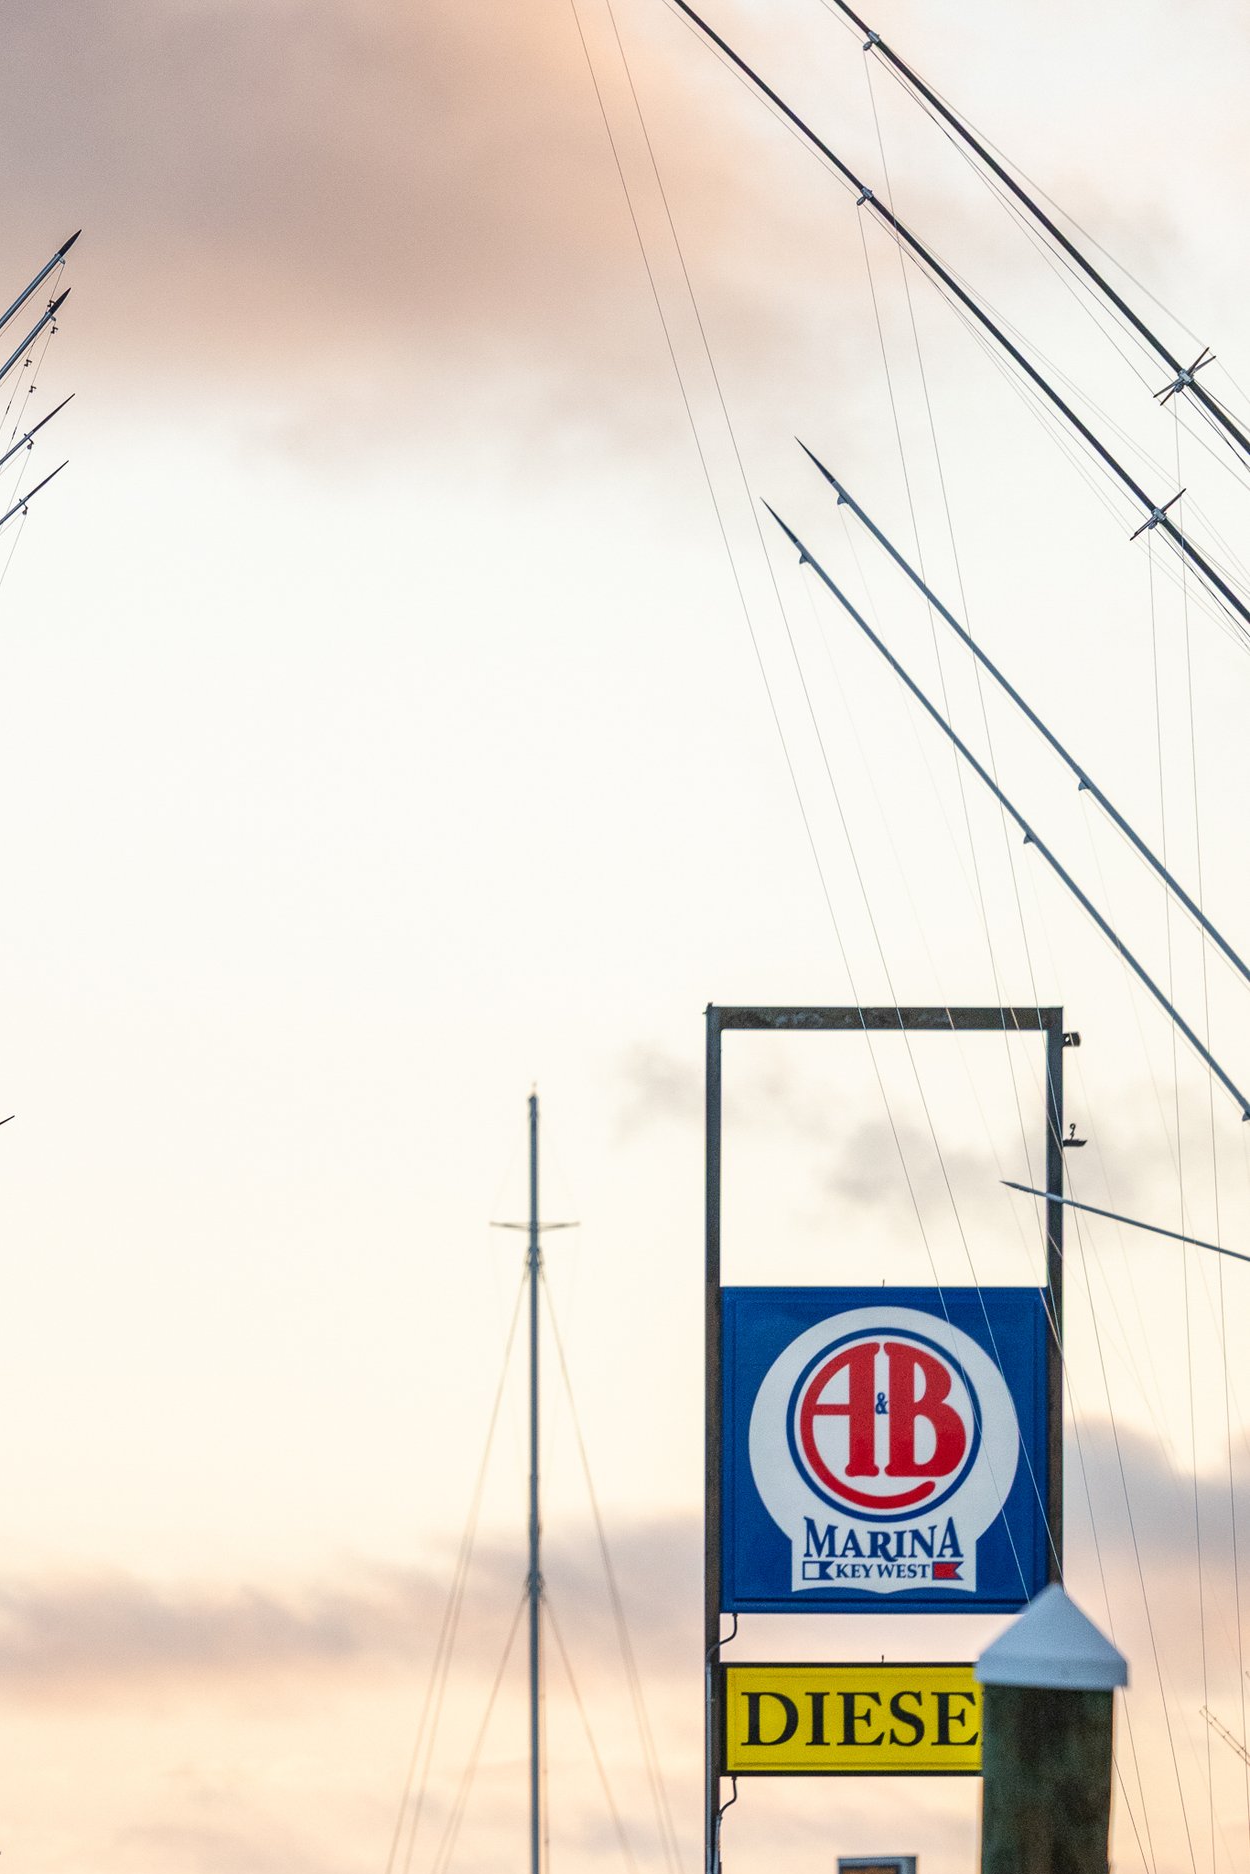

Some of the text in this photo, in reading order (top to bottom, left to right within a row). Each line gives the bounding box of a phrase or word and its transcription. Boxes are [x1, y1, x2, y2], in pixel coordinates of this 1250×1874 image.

[803, 1515, 965, 1563] MARINA
[835, 1563, 931, 1579] KEY WEST
[740, 1690, 984, 1747] DIESE
